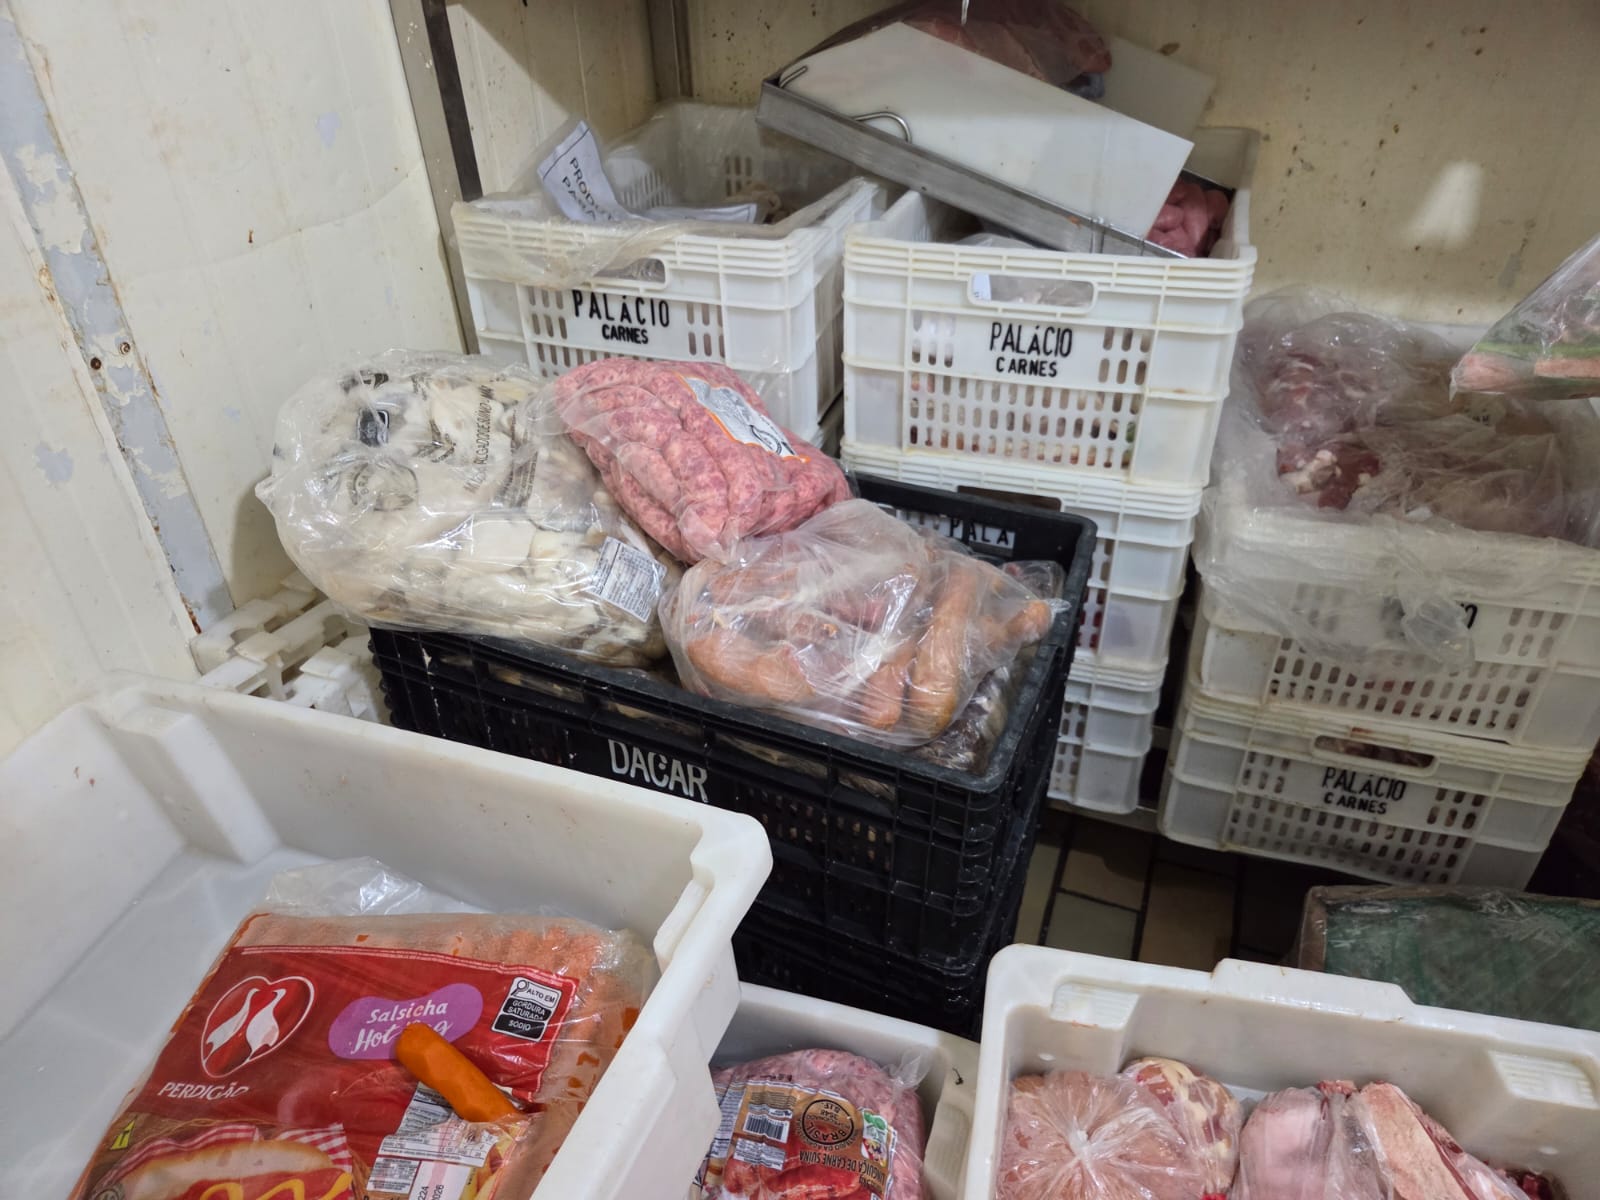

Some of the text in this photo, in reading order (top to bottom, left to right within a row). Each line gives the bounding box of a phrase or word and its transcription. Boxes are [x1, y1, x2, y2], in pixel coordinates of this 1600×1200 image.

[572, 289, 670, 327] PALÁCIO
[602, 324, 649, 344] CARNES
[990, 321, 1073, 358] PALÁCIO
[996, 356, 1058, 378] CARNES
[949, 517, 1009, 546] PALA
[608, 739, 709, 803] DACAR
[1322, 766, 1407, 802] PALÁCIO
[1323, 791, 1387, 815] CARNES
[526, 988, 556, 1004] ALTO EM
[366, 999, 449, 1024] Salsicha
[512, 1000, 546, 1016] GORDURA
[350, 1023, 400, 1055] Hot
[157, 1081, 250, 1100] PERDIGÃO
[807, 1122, 847, 1141] BRASIL
[823, 1153, 846, 1169] CARNE
[846, 1159, 857, 1172] DE
